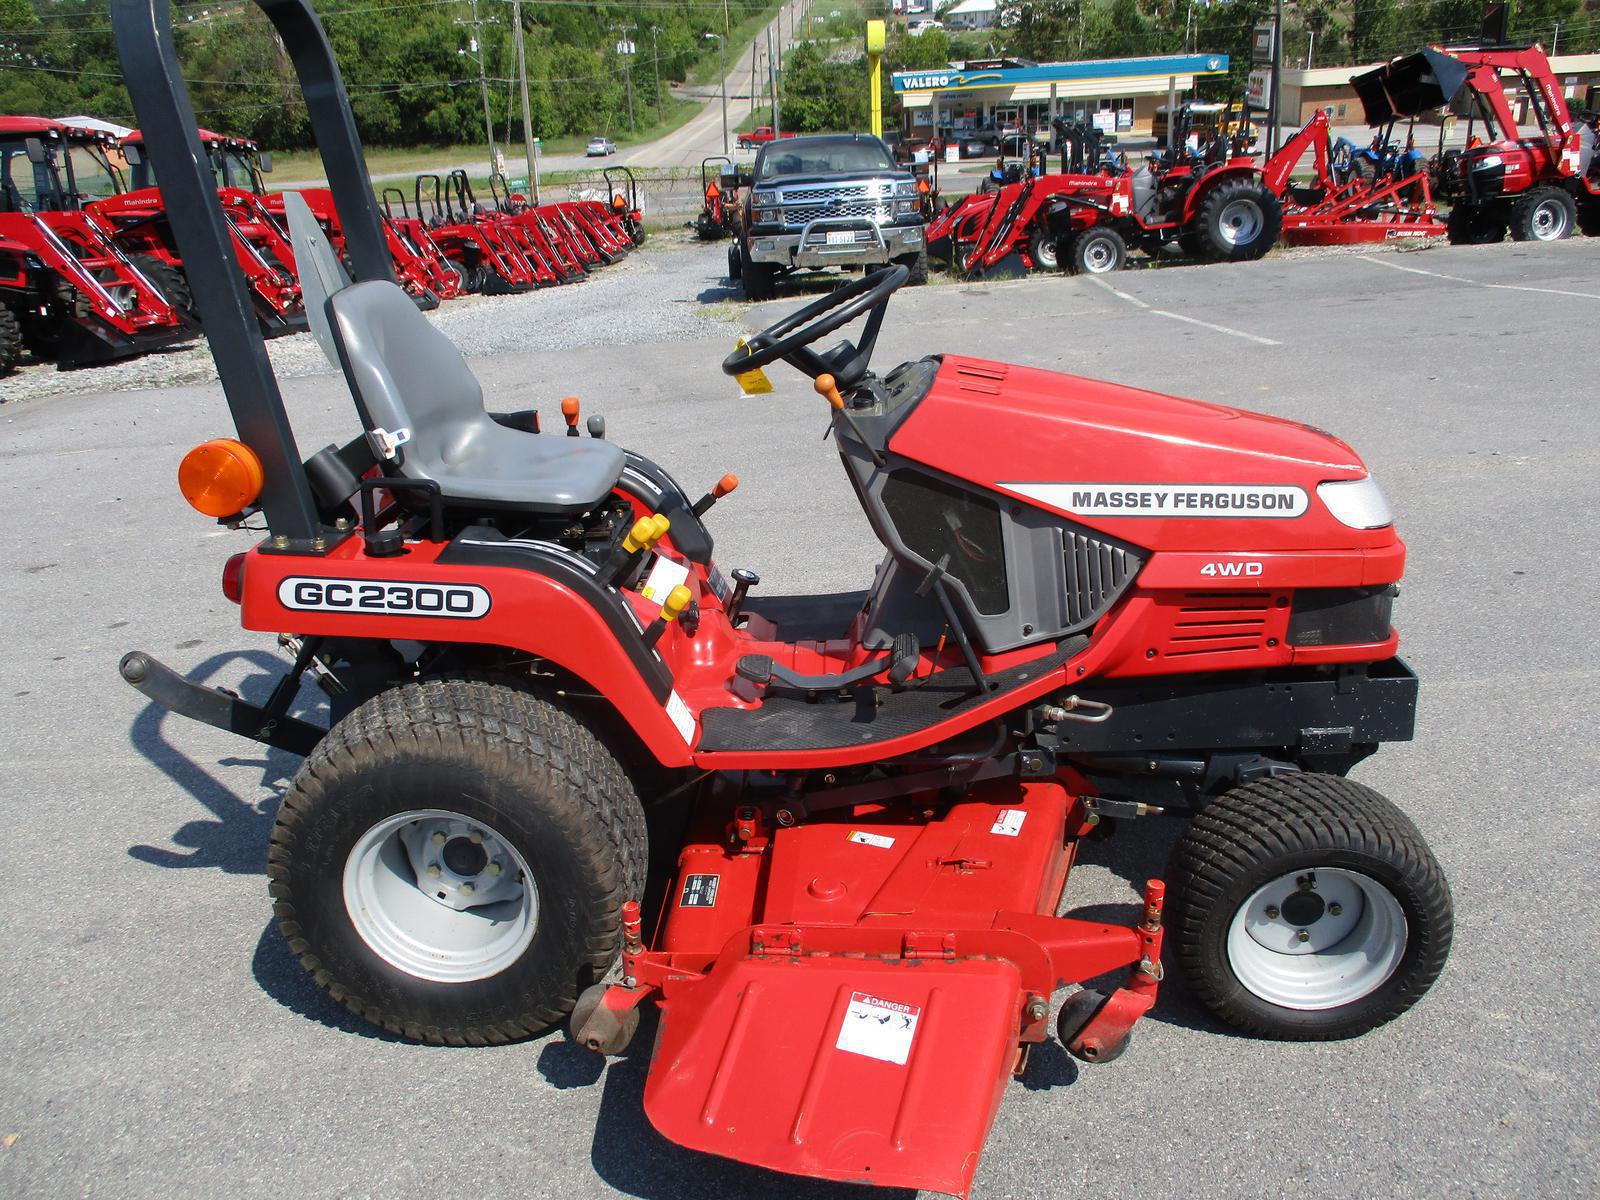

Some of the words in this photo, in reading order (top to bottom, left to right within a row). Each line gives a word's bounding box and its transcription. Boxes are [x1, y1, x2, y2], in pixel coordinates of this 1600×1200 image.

[903, 76, 949, 89] VALERO
[124, 198, 157, 206] Mahindra
[1072, 491, 1169, 509] MASSEY
[1173, 492, 1294, 510] FERGUSON
[1200, 561, 1263, 577] 4WD
[871, 998, 911, 1013] DANGER
